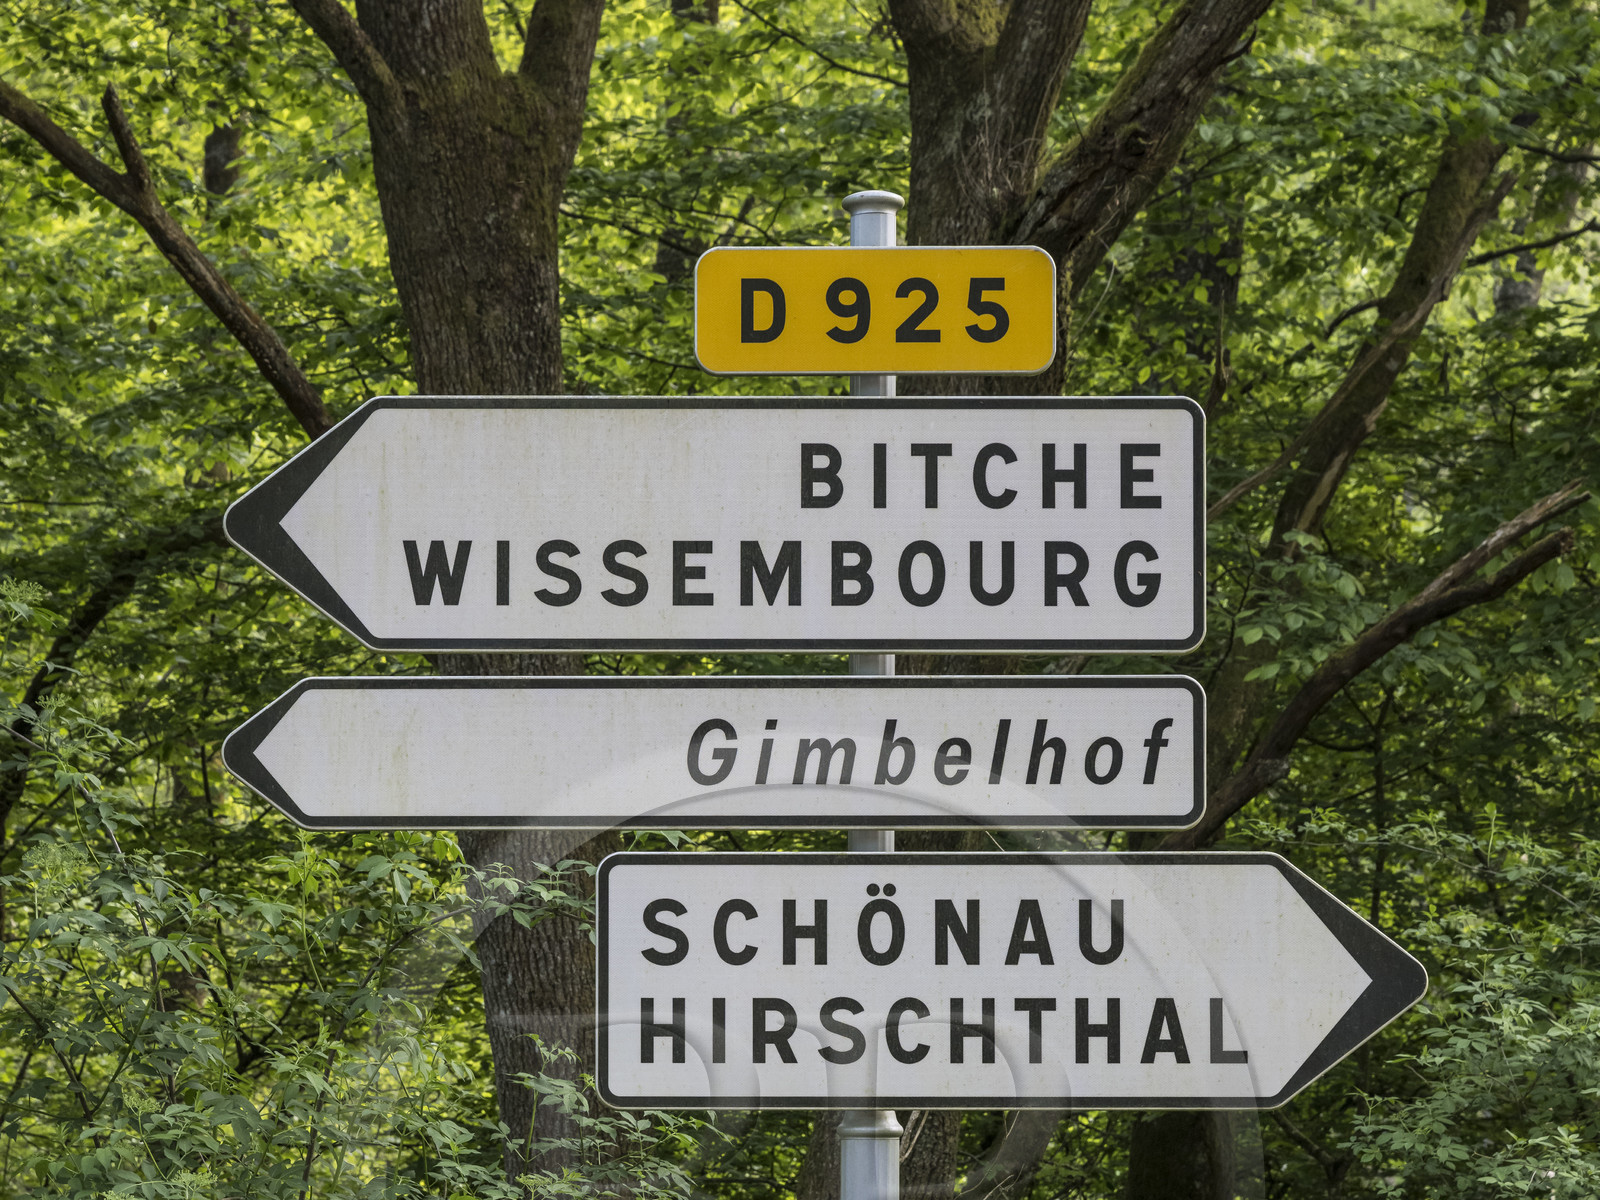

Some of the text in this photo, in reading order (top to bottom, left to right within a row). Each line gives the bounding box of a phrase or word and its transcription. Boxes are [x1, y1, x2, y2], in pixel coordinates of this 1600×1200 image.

[741, 277, 1010, 344] D 925
[800, 442, 1162, 510] BITCHE
[402, 539, 1162, 607] WISSEMBOURG
[686, 717, 1174, 786] Gimbelhof
[641, 882, 1125, 967] SCHÖNAU
[640, 996, 1249, 1065] HIRSCHTHAL
